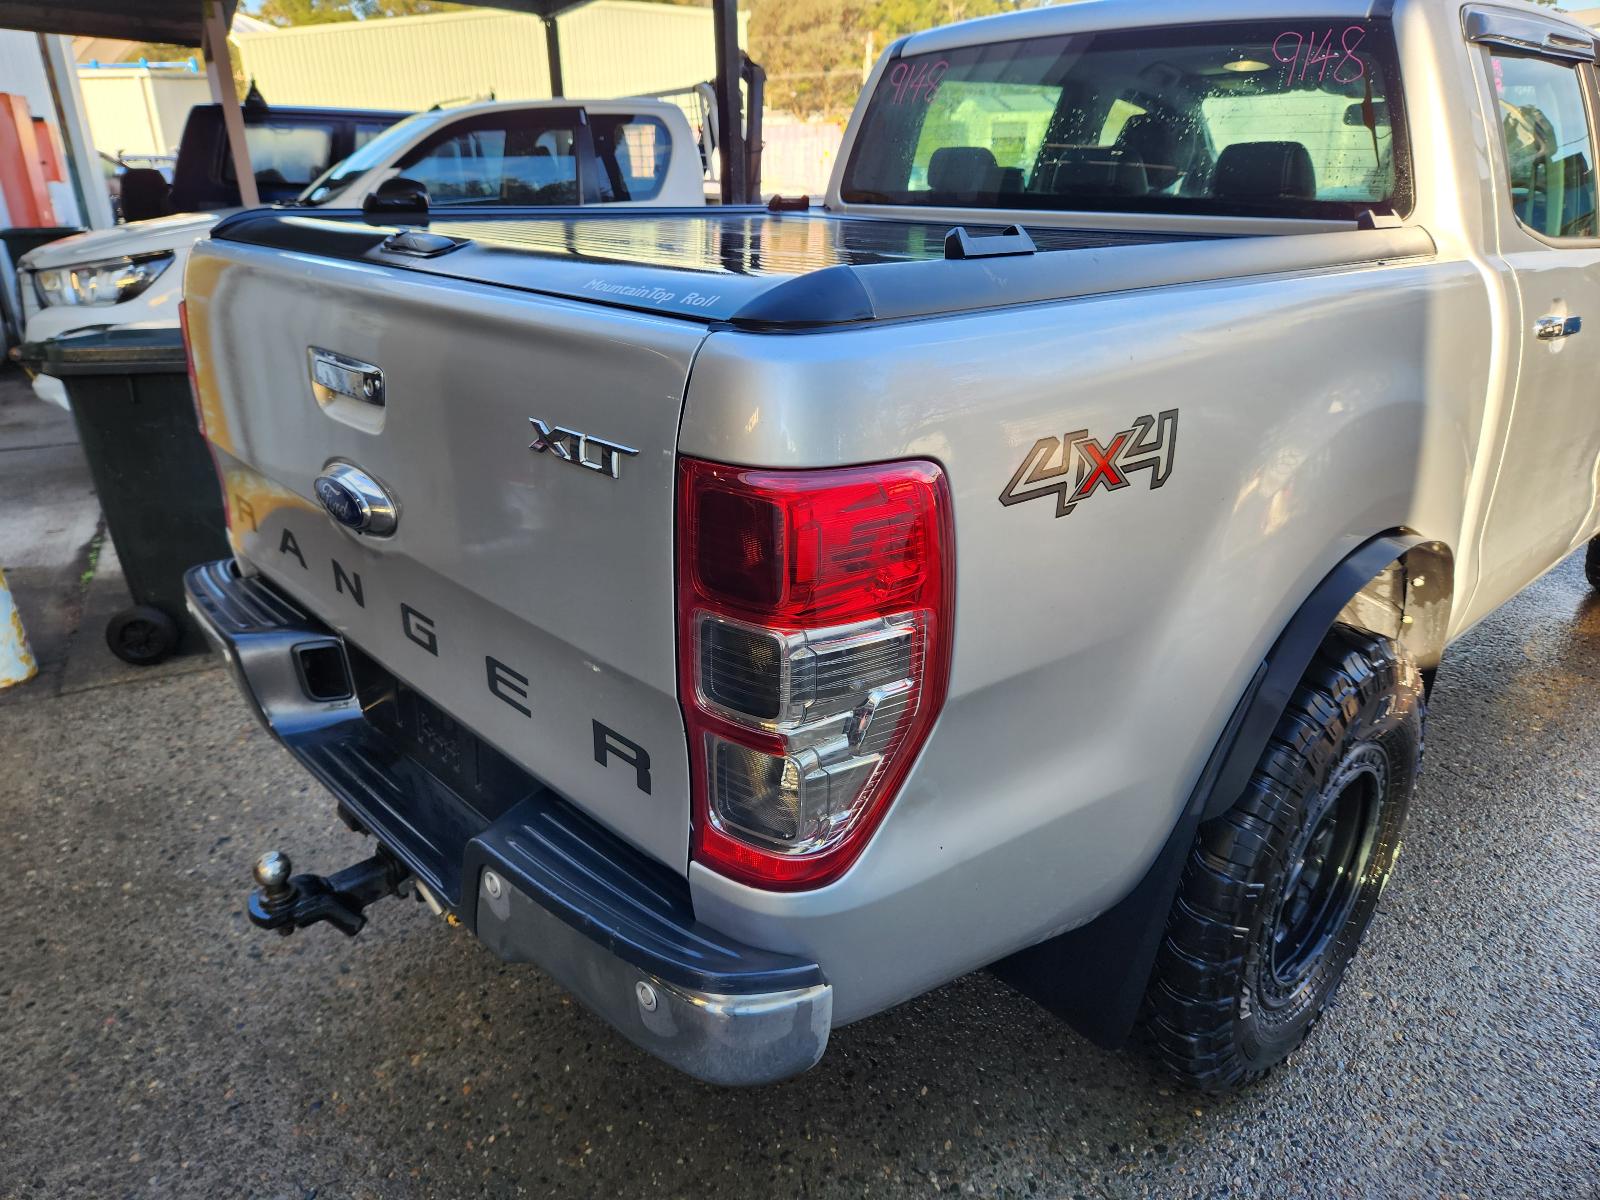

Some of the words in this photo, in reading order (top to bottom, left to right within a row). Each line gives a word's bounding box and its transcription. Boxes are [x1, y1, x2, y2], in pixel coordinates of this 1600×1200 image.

[890, 60, 949, 104] 9148
[1272, 26, 1366, 86] 9148
[583, 279, 676, 304] MountainTop
[680, 292, 721, 308] Roll
[529, 417, 640, 479] XLT
[234, 493, 652, 796] RANGER
